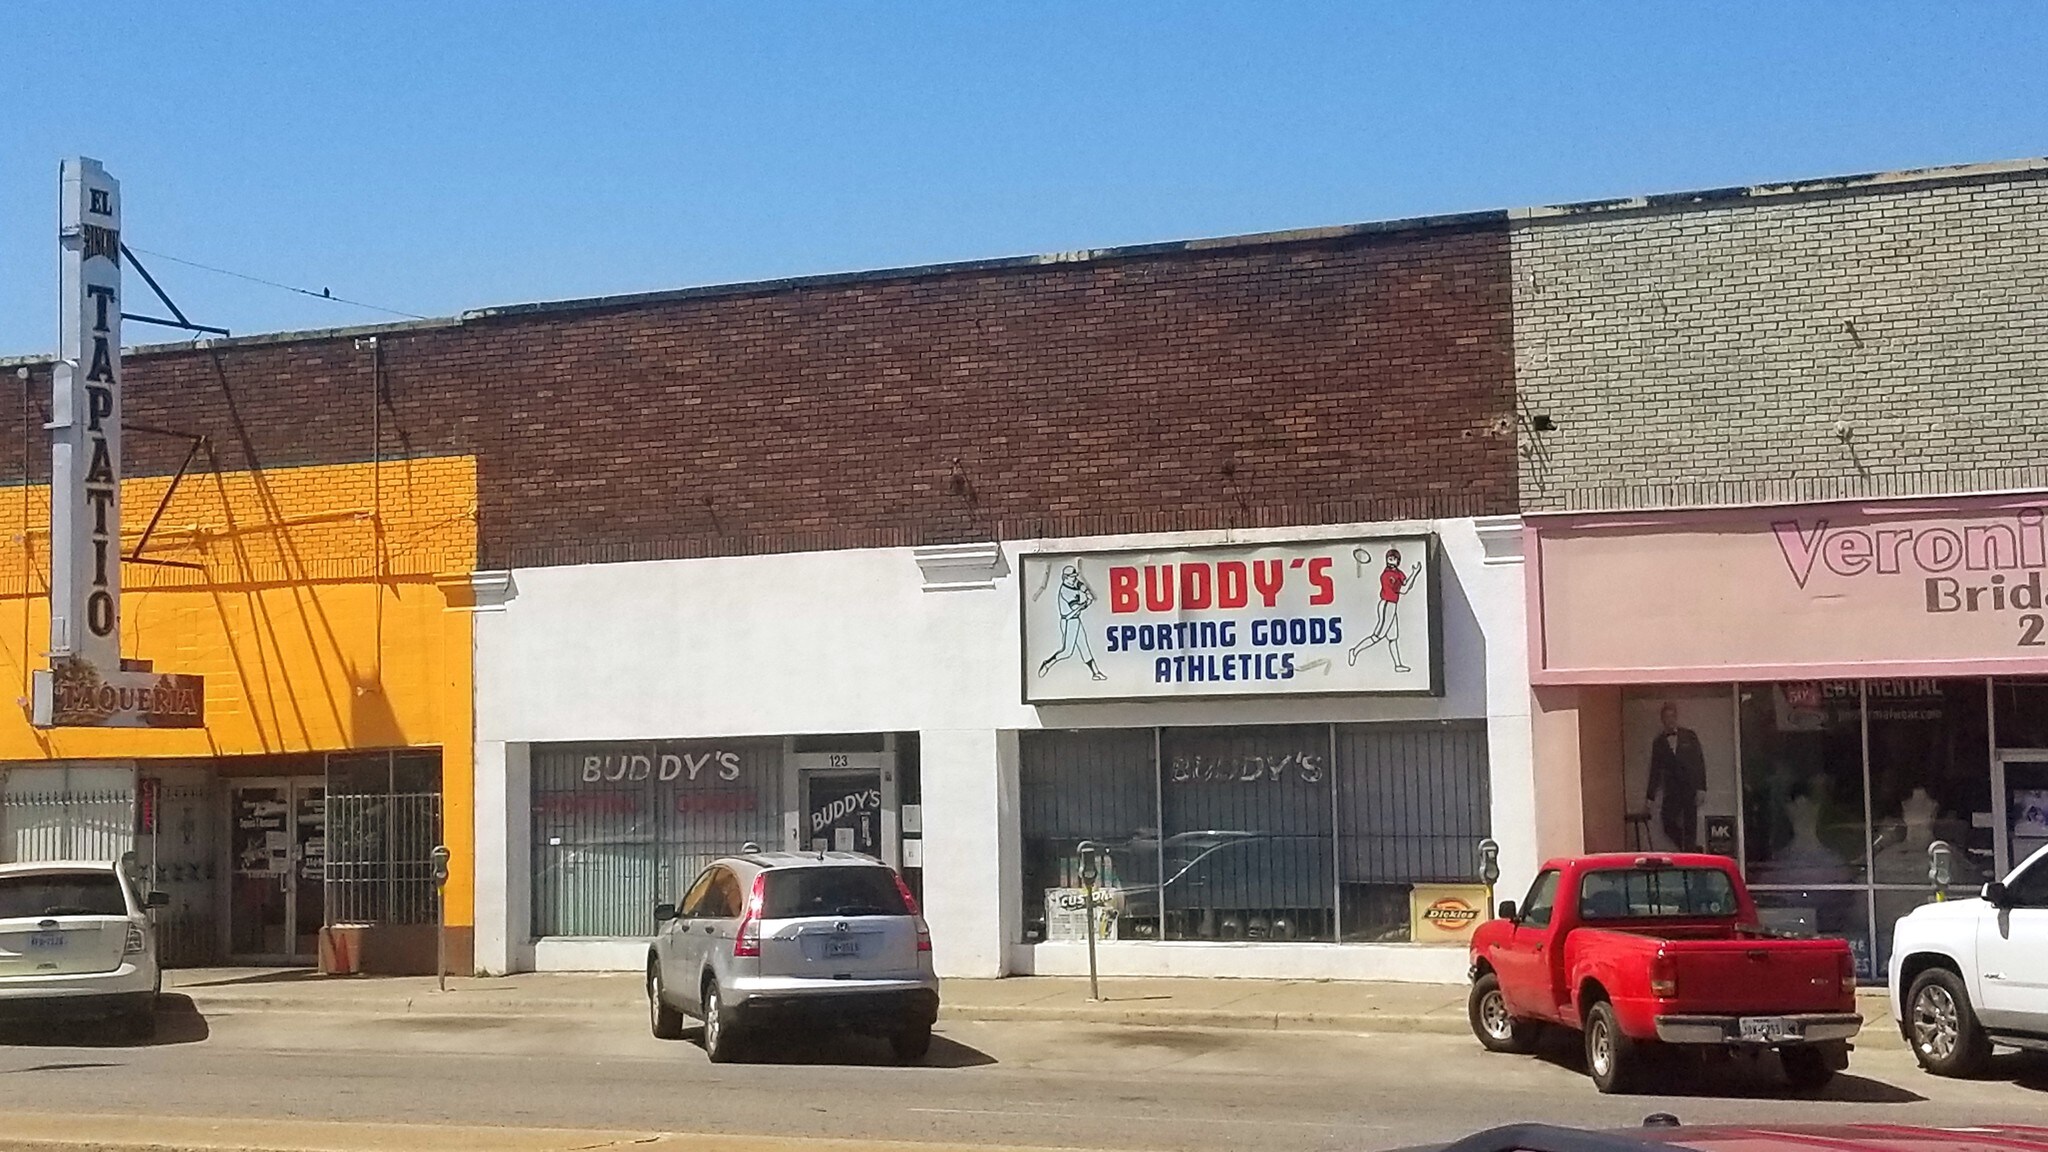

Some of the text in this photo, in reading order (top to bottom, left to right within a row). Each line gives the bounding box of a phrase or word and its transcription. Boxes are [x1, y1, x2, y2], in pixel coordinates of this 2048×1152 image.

[89, 187, 113, 217] EL
[85, 284, 117, 637] TAPATIO
[1109, 557, 1334, 613] BUDDY'S
[1925, 571, 2048, 612] Brid
[1106, 617, 1342, 652] SPORTING GOODS
[1155, 653, 1295, 683] ATHLETICS
[582, 751, 740, 782] BUDDY'S
[829, 755, 848, 767] 123
[811, 788, 881, 832] BUDDY'S
[1711, 825, 1731, 838] MK
[1428, 910, 1475, 918] Dickies
